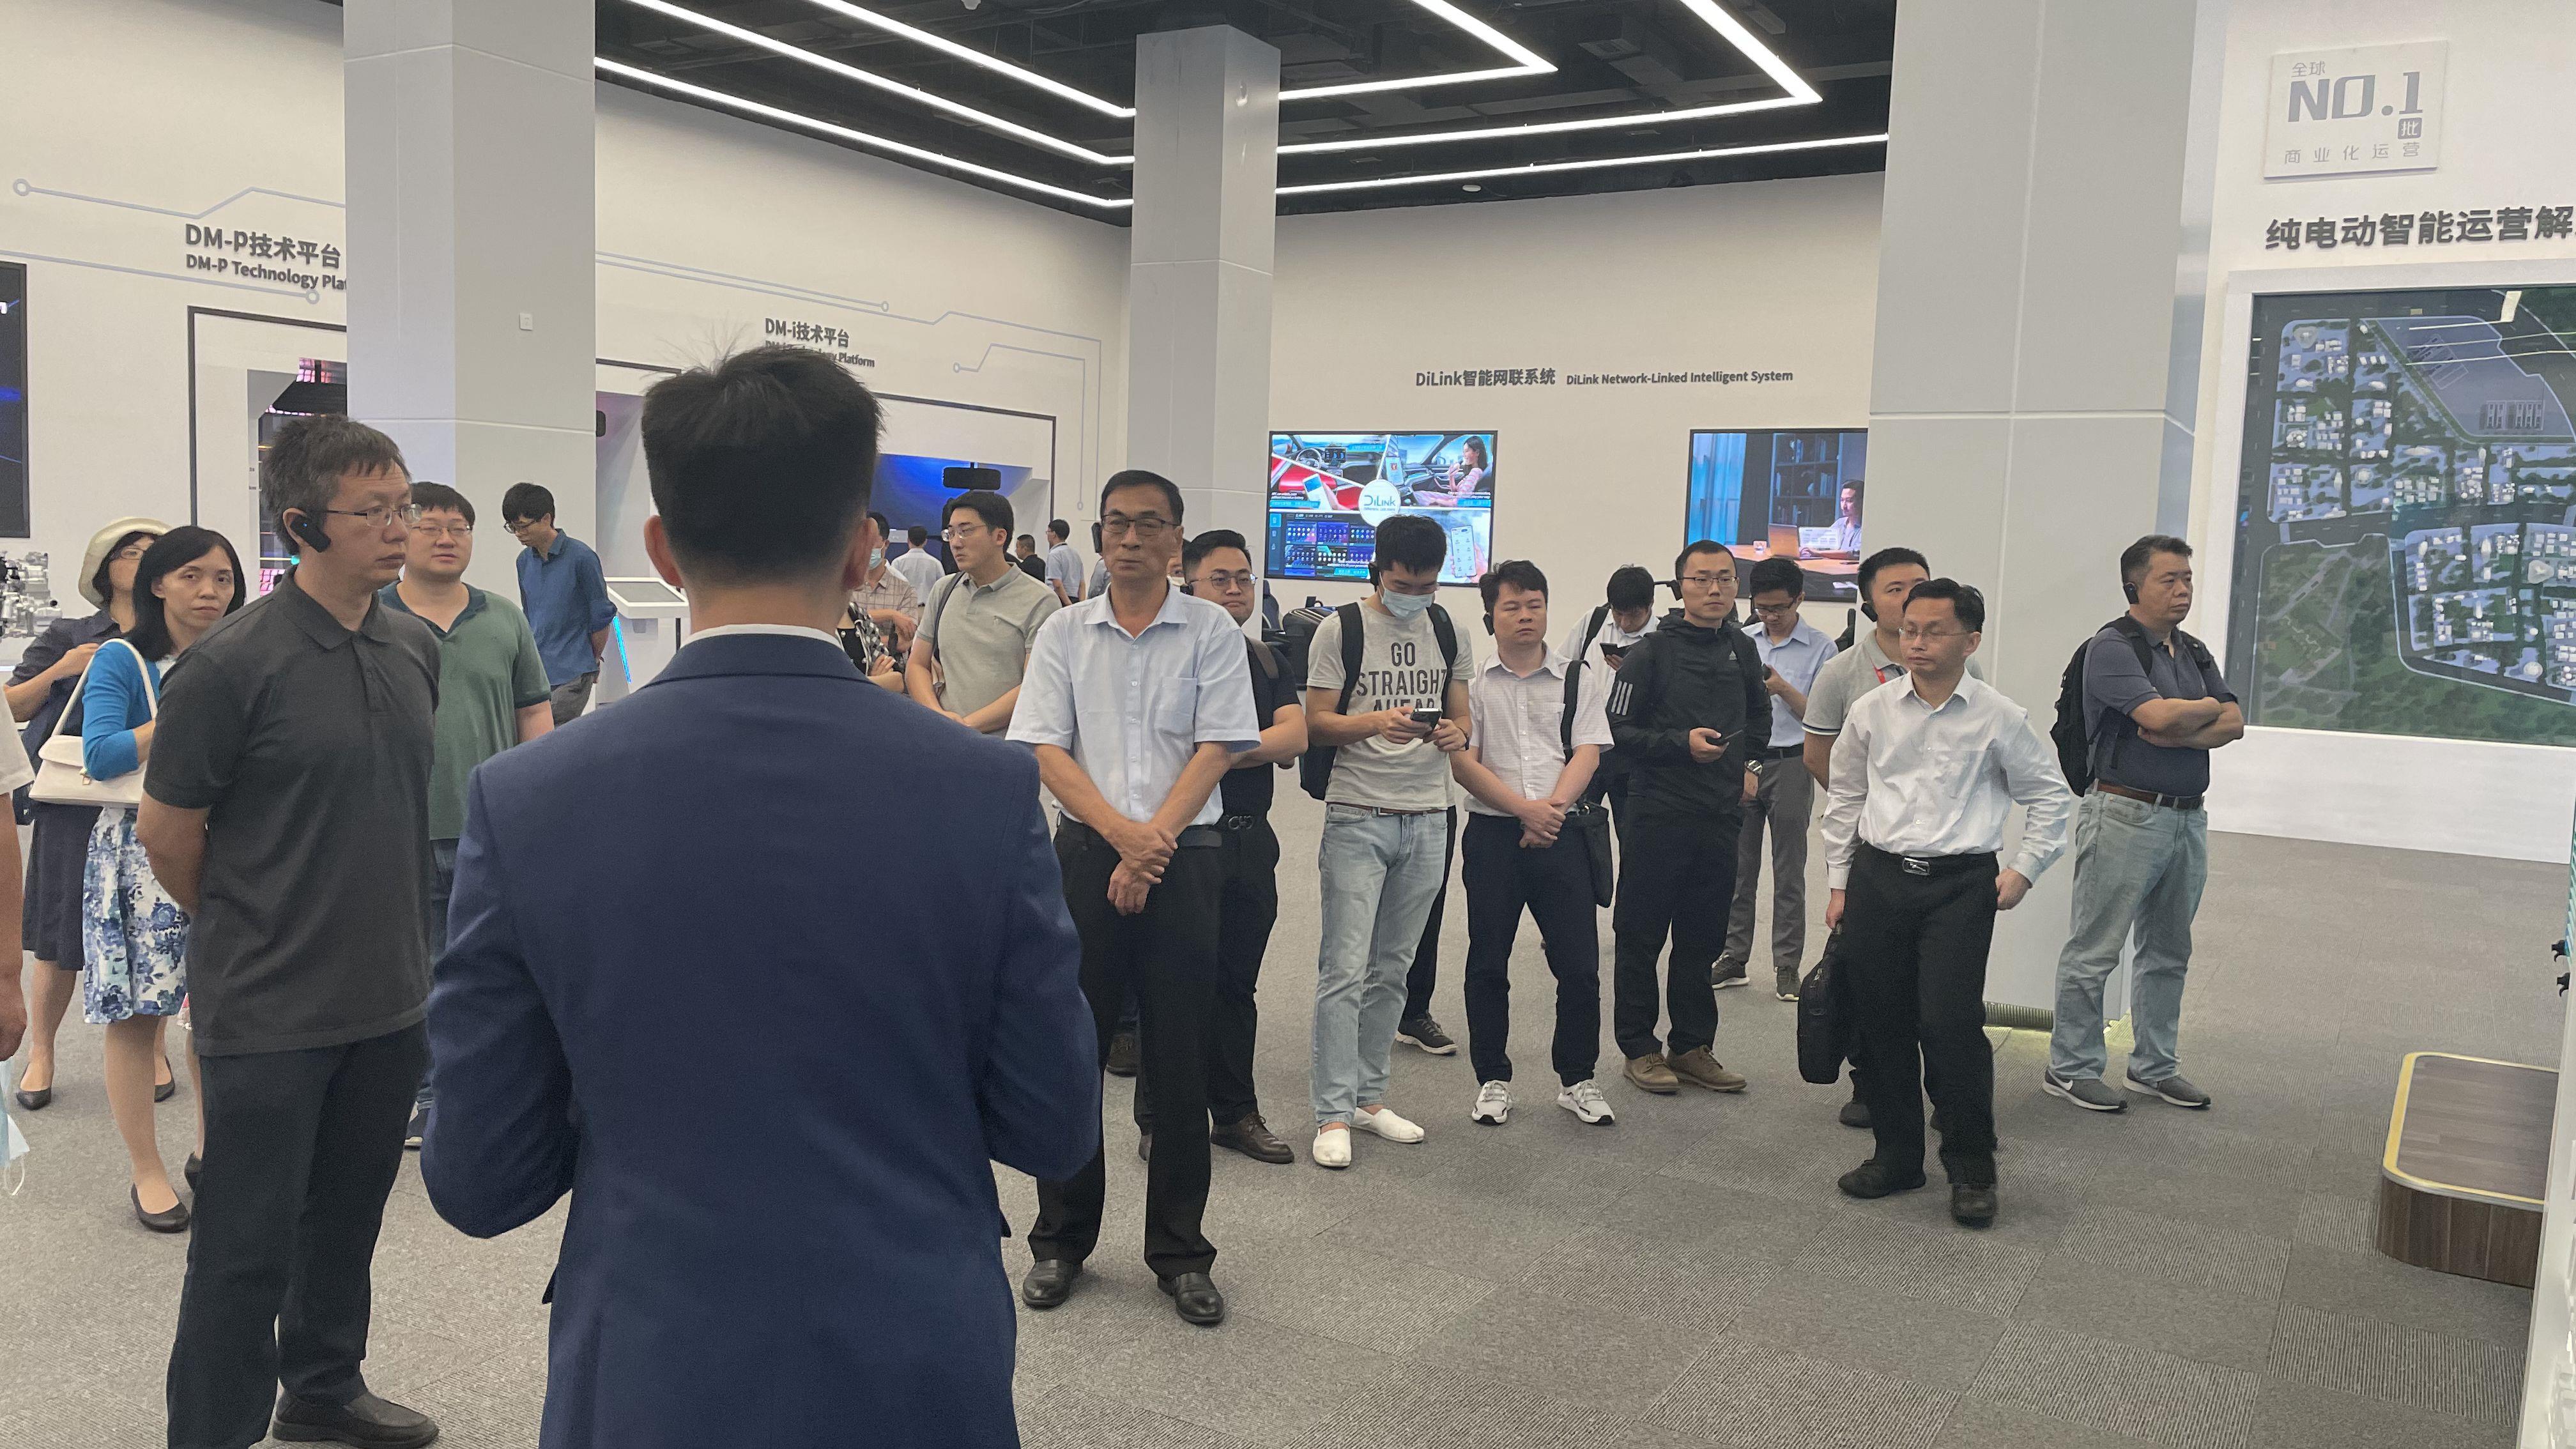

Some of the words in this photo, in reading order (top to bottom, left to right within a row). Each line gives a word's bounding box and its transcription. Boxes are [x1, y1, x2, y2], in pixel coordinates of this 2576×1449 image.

[2290, 61, 2326, 78] 全球
[2288, 72, 2423, 122] NO.1
[2400, 119, 2419, 137] 批
[2284, 142, 2419, 164] 商业化运营
[2266, 206, 2576, 250] 纯电动智能运营解
[185, 224, 341, 269] DM-P技术平台
[186, 254, 228, 272] DM-P
[232, 260, 318, 289] Technology
[765, 318, 849, 348] DM-i技术平台
[839, 352, 875, 367] Platform
[1416, 368, 1556, 387] DiLink智能网联系统
[1567, 374, 1599, 385] DiLink
[1602, 372, 1688, 384] Network-Linked
[1690, 371, 1749, 385] Intelligent
[1751, 371, 1793, 383] System
[1391, 642, 1415, 666] GO
[1356, 670, 1448, 696] STRAIGHT
